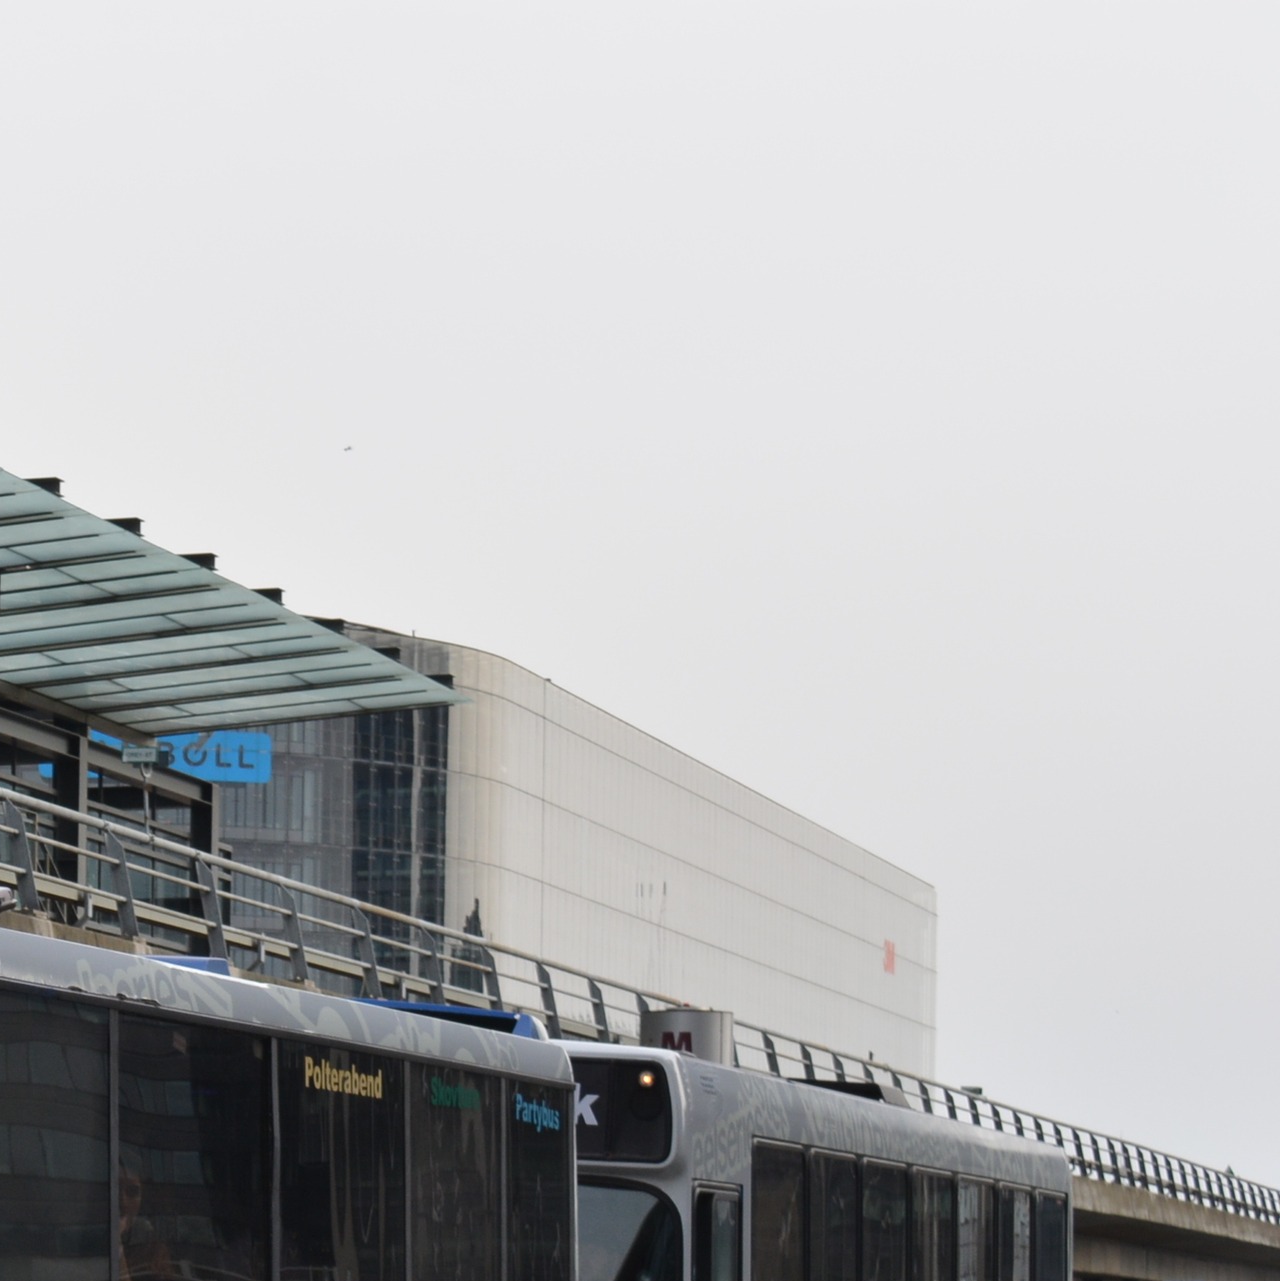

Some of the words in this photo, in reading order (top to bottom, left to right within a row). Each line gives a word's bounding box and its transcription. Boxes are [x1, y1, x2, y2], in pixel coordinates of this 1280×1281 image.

[662, 1031, 692, 1052] M
[305, 1056, 383, 1099] Polterabend
[515, 1093, 560, 1132] Partybus
